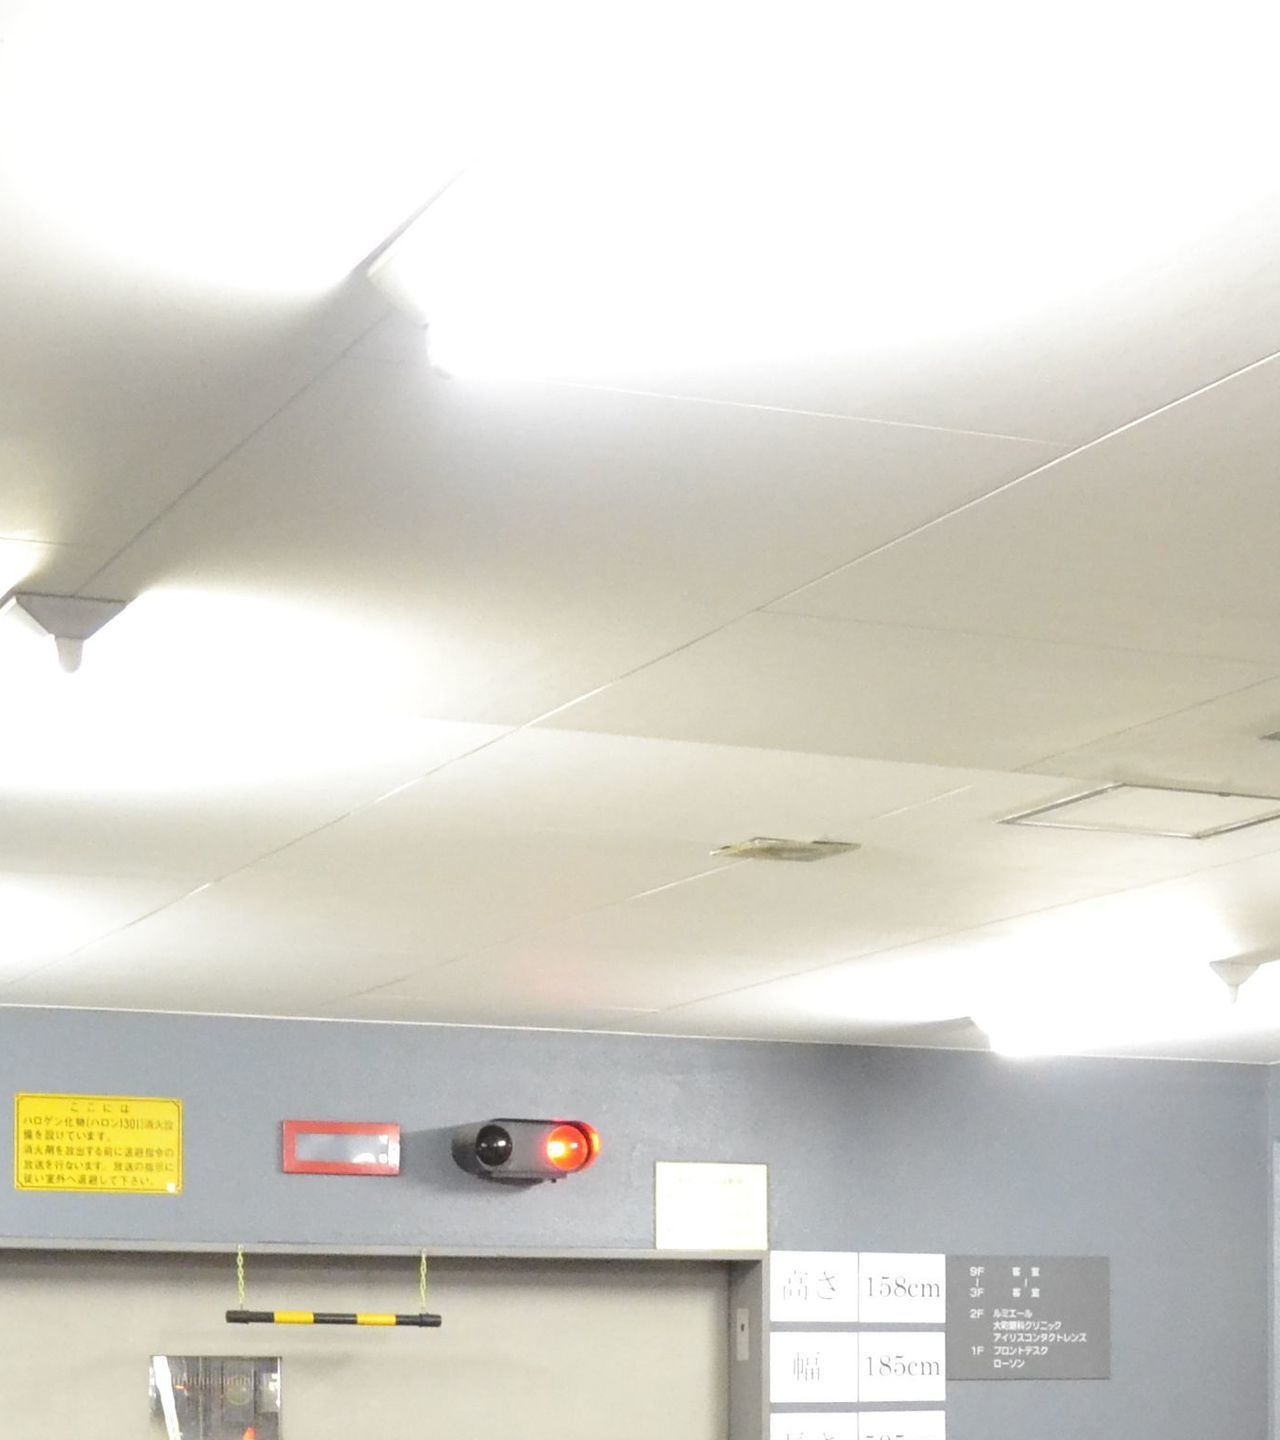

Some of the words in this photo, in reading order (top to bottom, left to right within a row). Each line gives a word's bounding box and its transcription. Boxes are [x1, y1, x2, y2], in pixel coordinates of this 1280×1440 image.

[969, 1266, 985, 1277] 9F
[782, 1269, 836, 1301] 高さ
[867, 1275, 941, 1299] 158cm
[969, 1287, 985, 1298] 3F
[969, 1308, 984, 1319] 2F
[971, 1346, 985, 1356] 1F
[793, 1351, 821, 1382] 幅
[866, 1354, 941, 1377] 185cm
[993, 1359, 1025, 1369] ローソン
